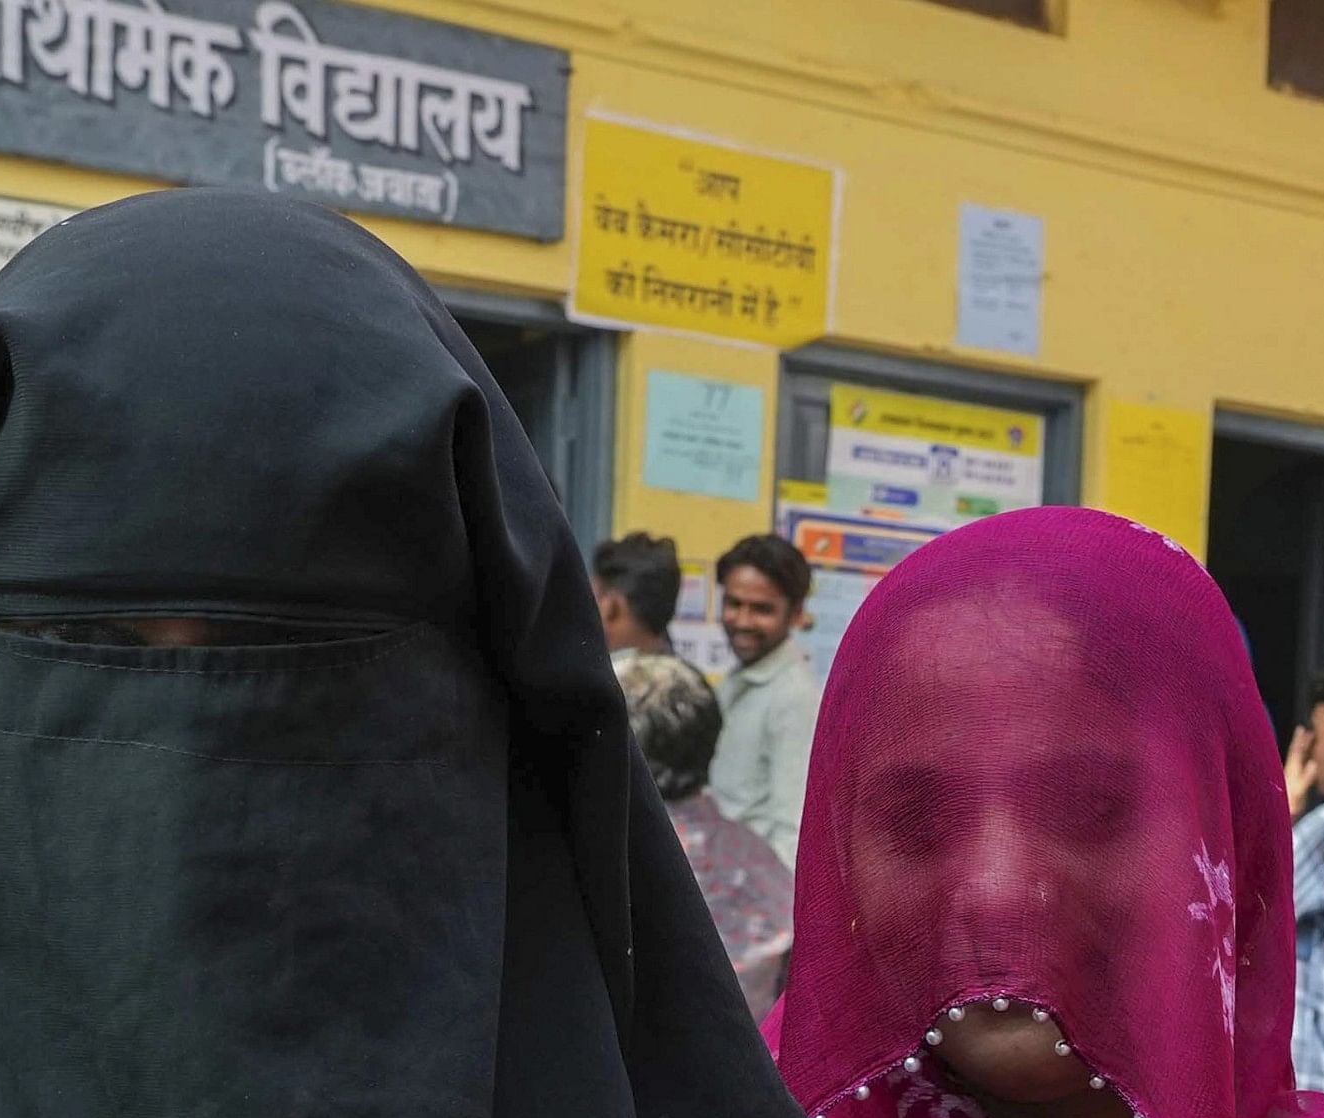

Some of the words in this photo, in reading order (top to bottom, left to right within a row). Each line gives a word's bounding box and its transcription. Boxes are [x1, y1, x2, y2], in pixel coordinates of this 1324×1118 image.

[249, 2, 532, 170] विद्यालय
[605, 260, 636, 297] की
[641, 264, 733, 316] निगरानी
